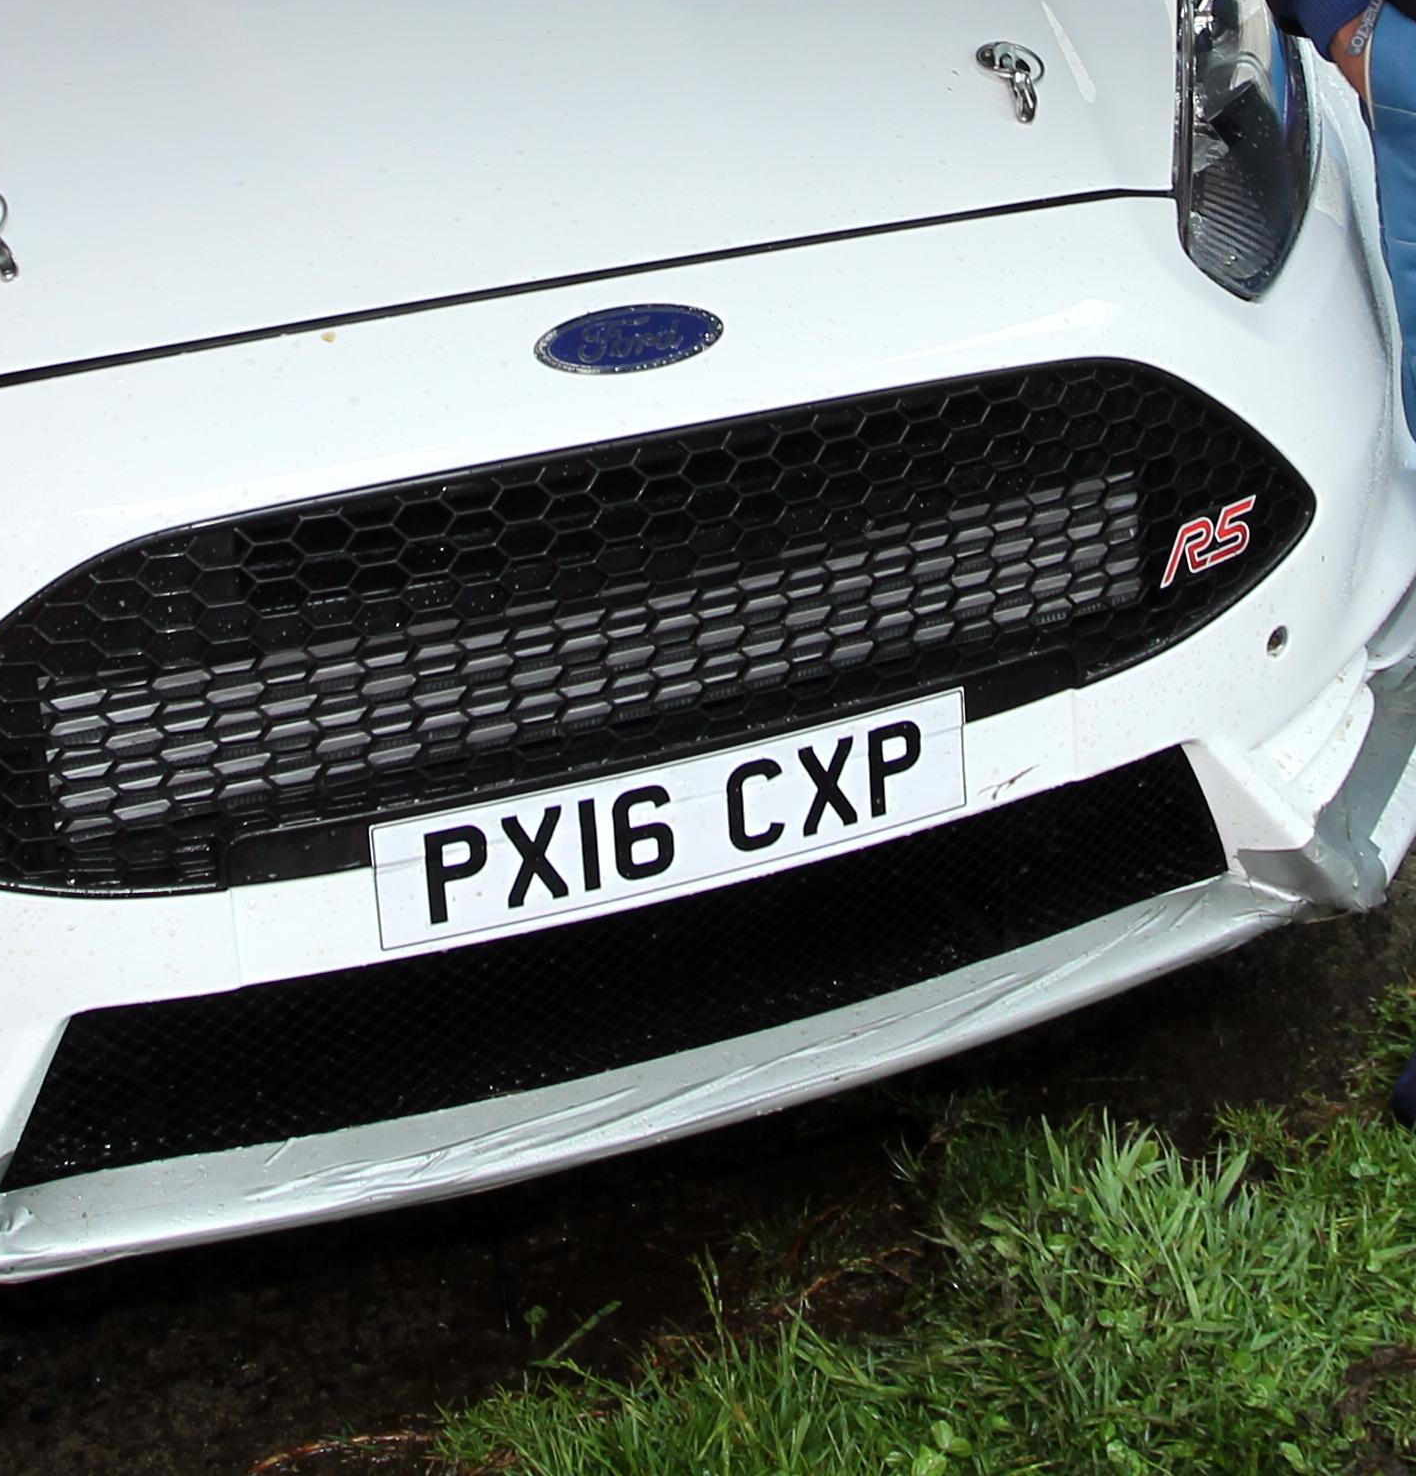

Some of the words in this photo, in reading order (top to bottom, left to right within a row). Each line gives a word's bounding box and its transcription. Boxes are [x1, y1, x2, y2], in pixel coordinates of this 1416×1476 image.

[577, 316, 684, 363] Ford
[423, 784, 675, 926] PX16
[726, 720, 922, 853] CXP
